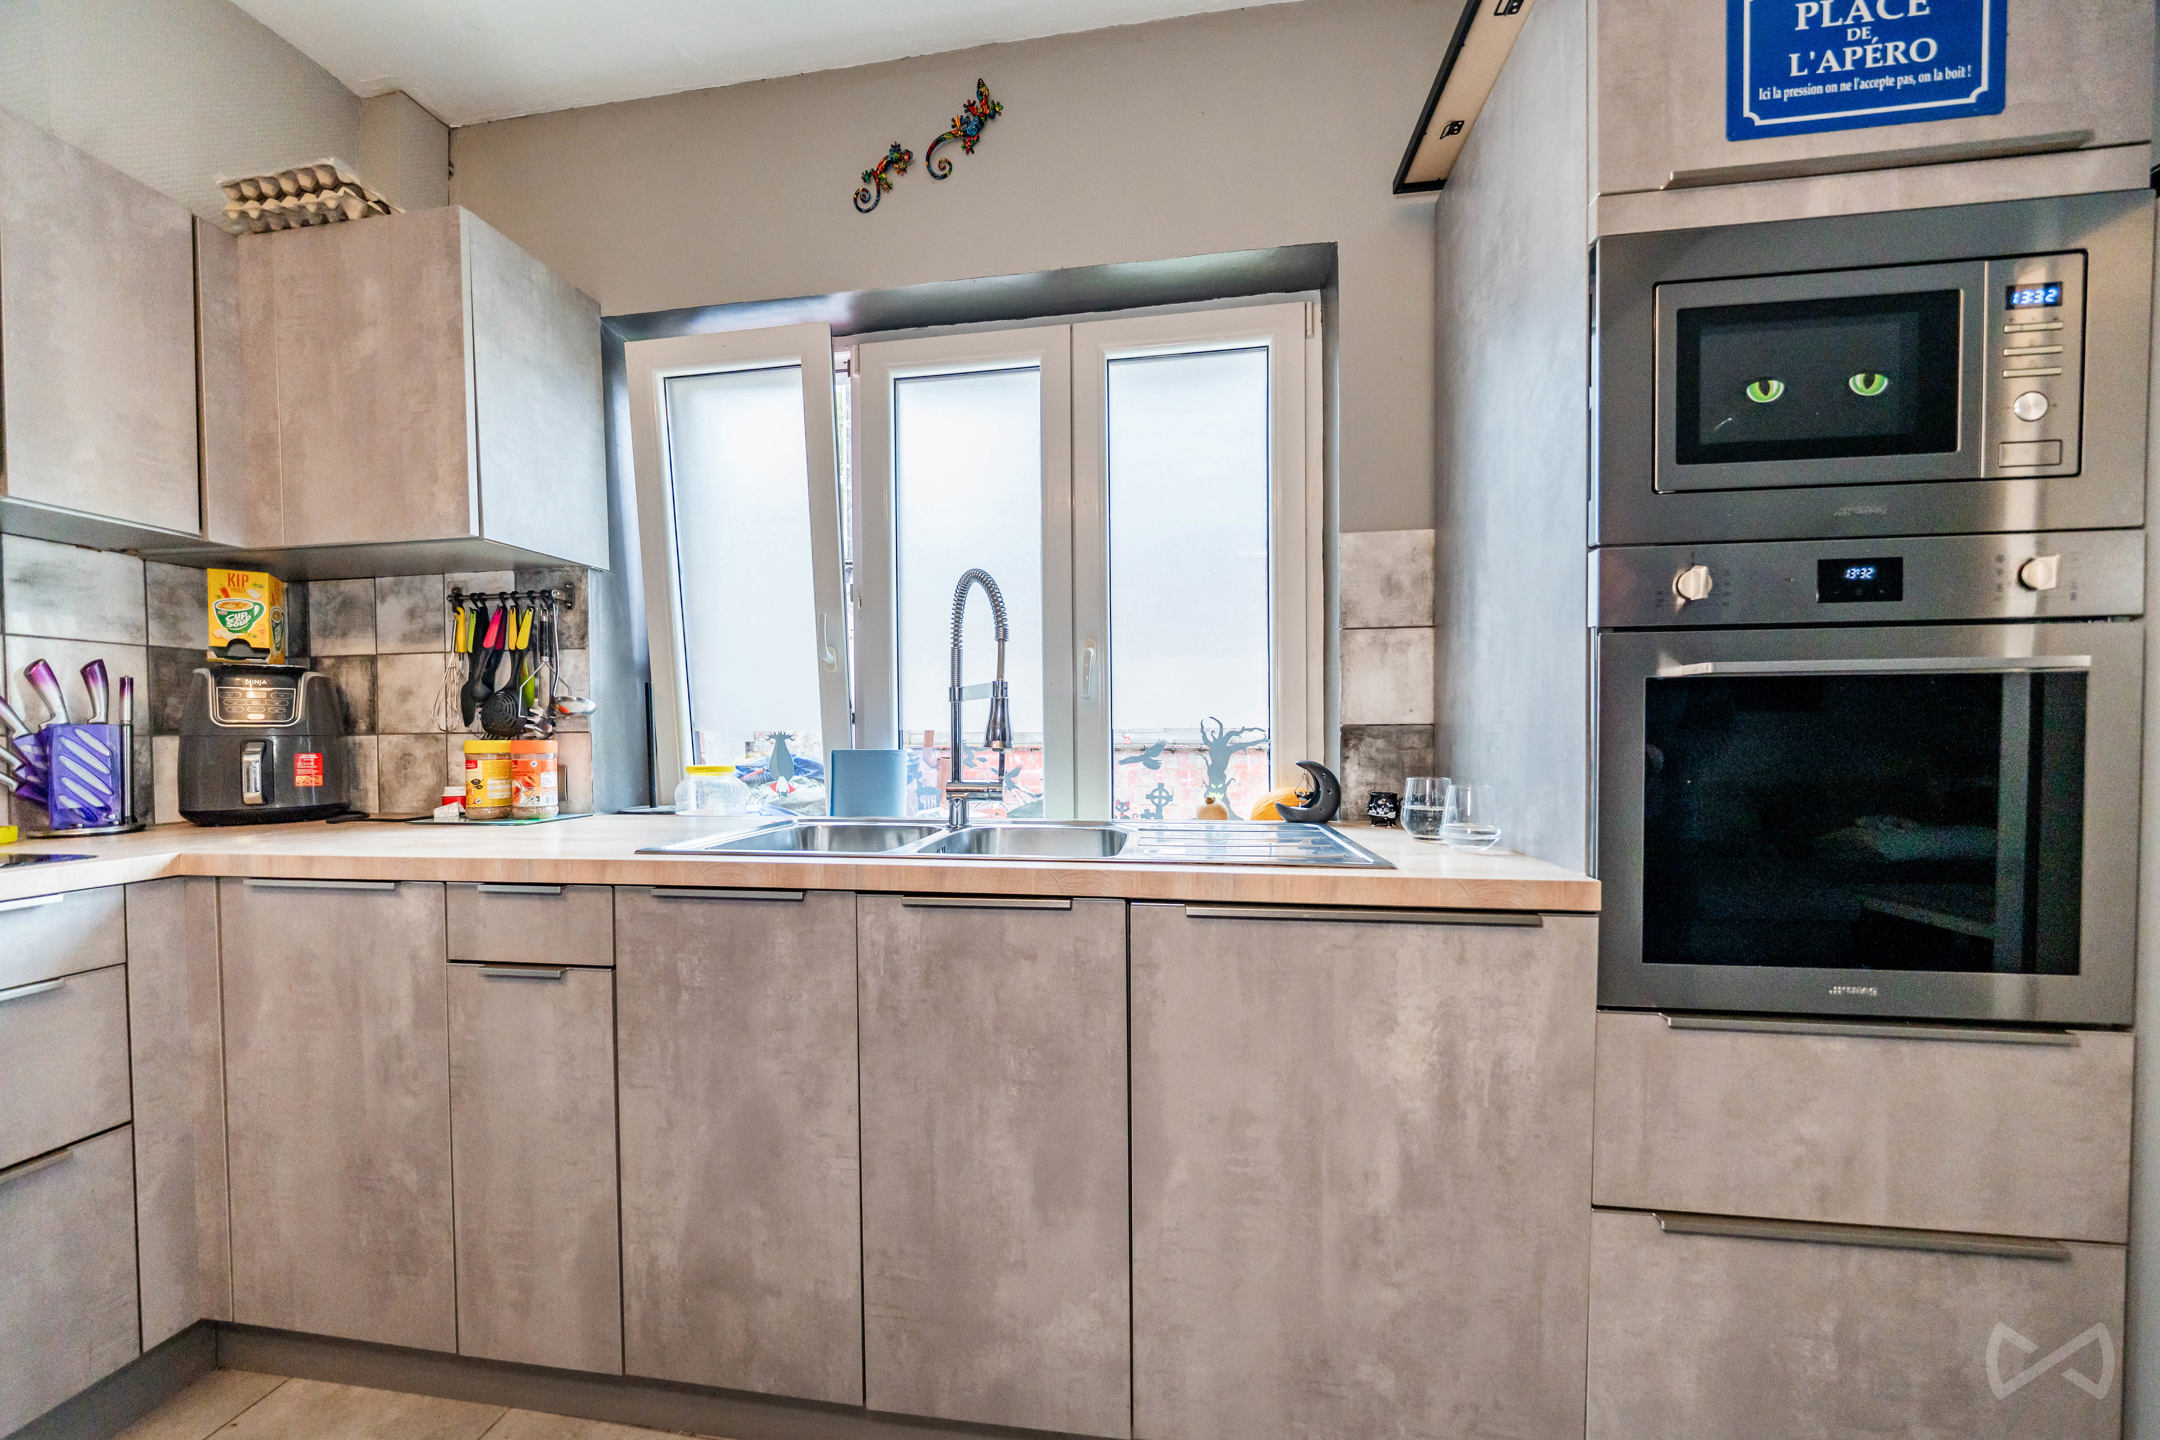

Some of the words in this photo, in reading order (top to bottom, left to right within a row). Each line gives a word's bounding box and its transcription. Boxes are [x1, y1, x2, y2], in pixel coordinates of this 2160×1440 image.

[1795, 0, 1930, 30] PLACE
[1846, 26, 1872, 41] DE
[1789, 37, 1938, 77] L'APÉRO
[1758, 87, 1771, 101] Ici
[1772, 86, 1783, 99] la
[1783, 82, 1823, 102] pression
[1825, 83, 1838, 93] on
[1839, 81, 1852, 92] ne
[1853, 77, 1895, 91] l'accepte
[1897, 74, 1916, 89] pas,
[1917, 72, 1932, 84] on
[1933, 68, 1944, 81] la
[1945, 65, 1966, 80] boit
[227, 572, 249, 588] KIP
[245, 678, 268, 686] NINJA
